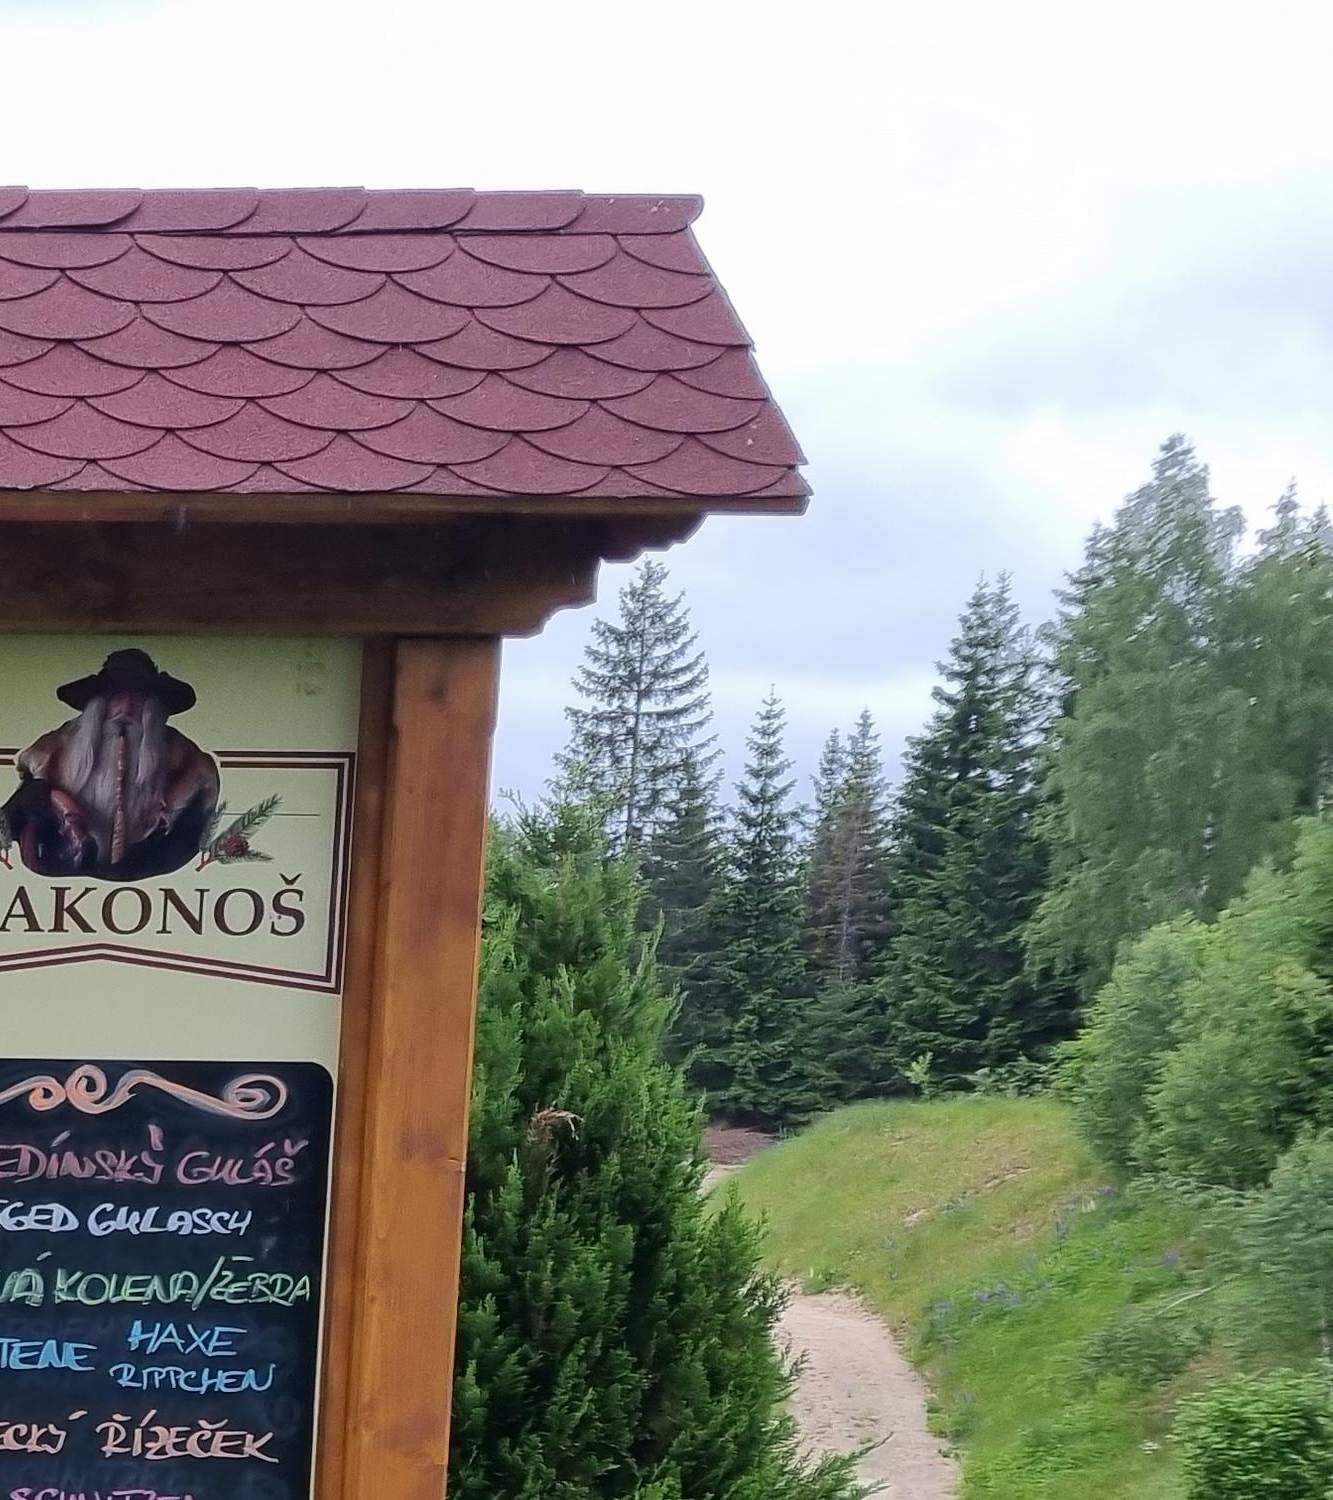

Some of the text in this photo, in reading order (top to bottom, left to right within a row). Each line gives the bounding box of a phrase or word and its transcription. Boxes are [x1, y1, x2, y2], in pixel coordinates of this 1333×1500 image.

[176, 1138, 309, 1187] GULÁŠ
[87, 1202, 252, 1237] GULASCH
[128, 1319, 248, 1357] HAXE
[109, 1363, 276, 1395] RIPPCHEN
[95, 1408, 279, 1464] ŘÍZEČEK
